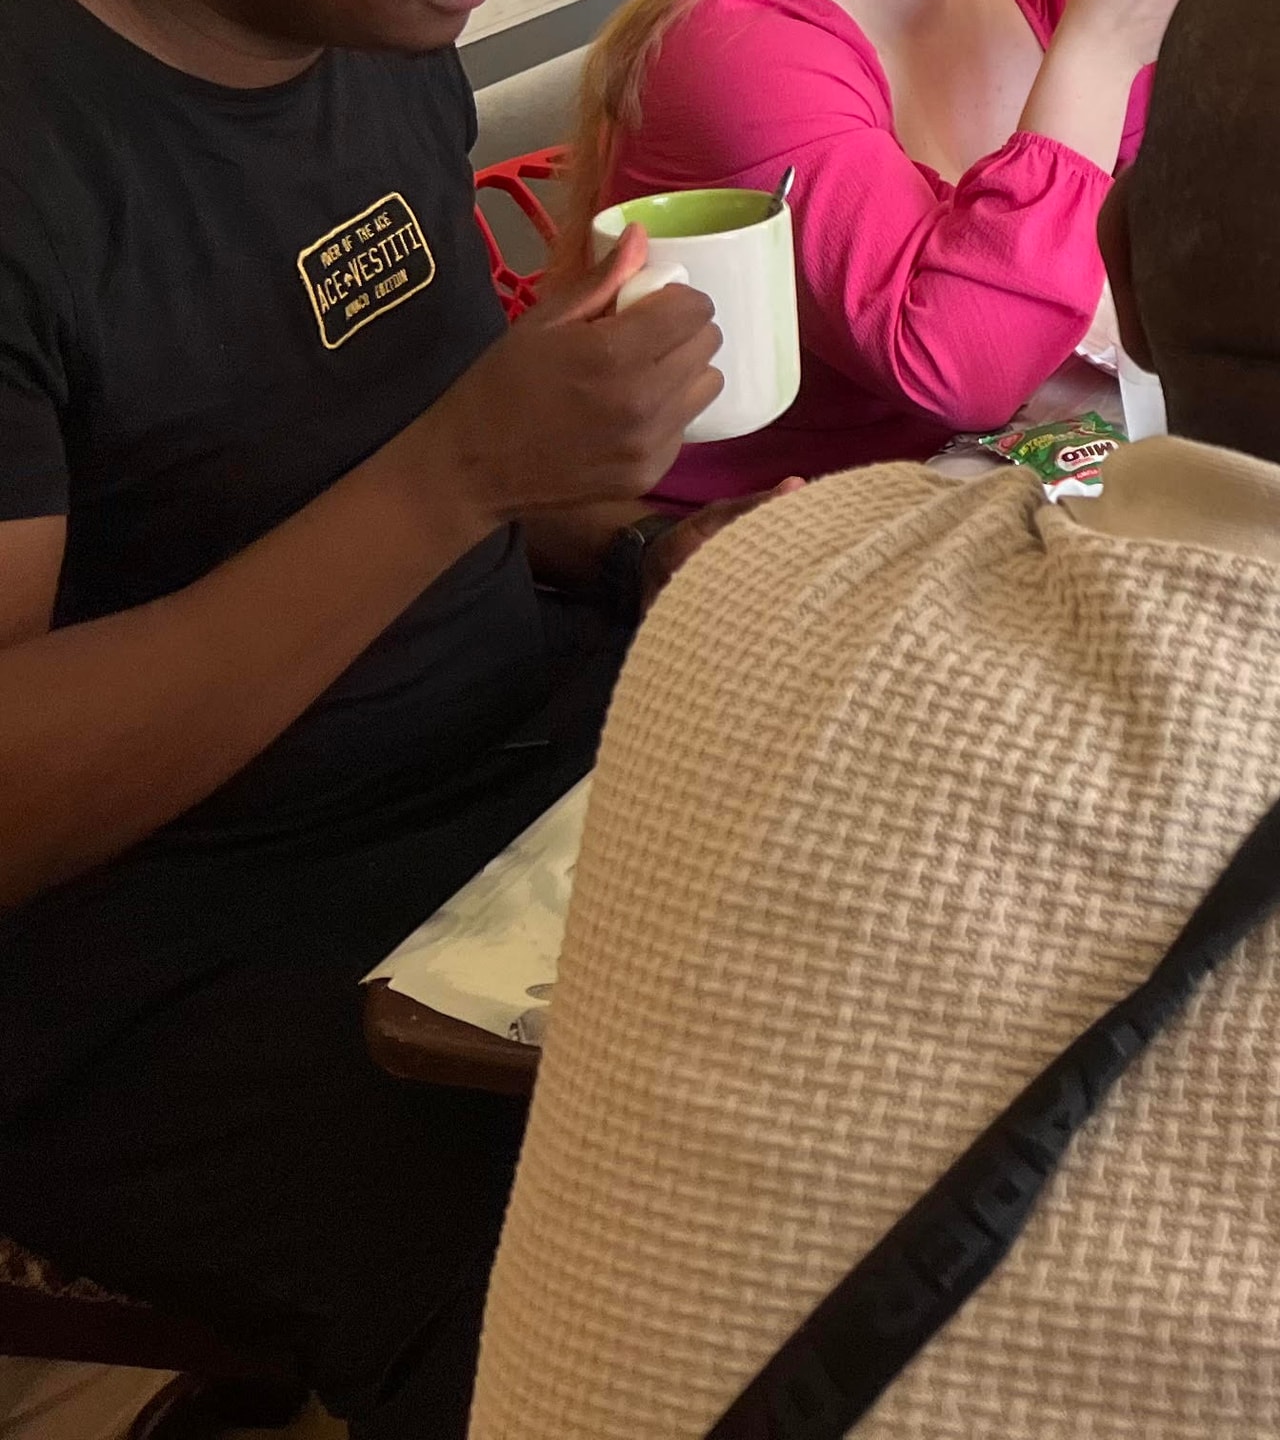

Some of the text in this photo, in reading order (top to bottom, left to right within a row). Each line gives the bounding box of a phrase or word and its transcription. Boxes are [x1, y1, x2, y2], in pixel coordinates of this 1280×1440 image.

[341, 234, 354, 253] OF
[355, 222, 376, 244] THE
[374, 211, 393, 233] ACE
[346, 222, 423, 287] VESTITI
[1061, 441, 1114, 463] MILO
